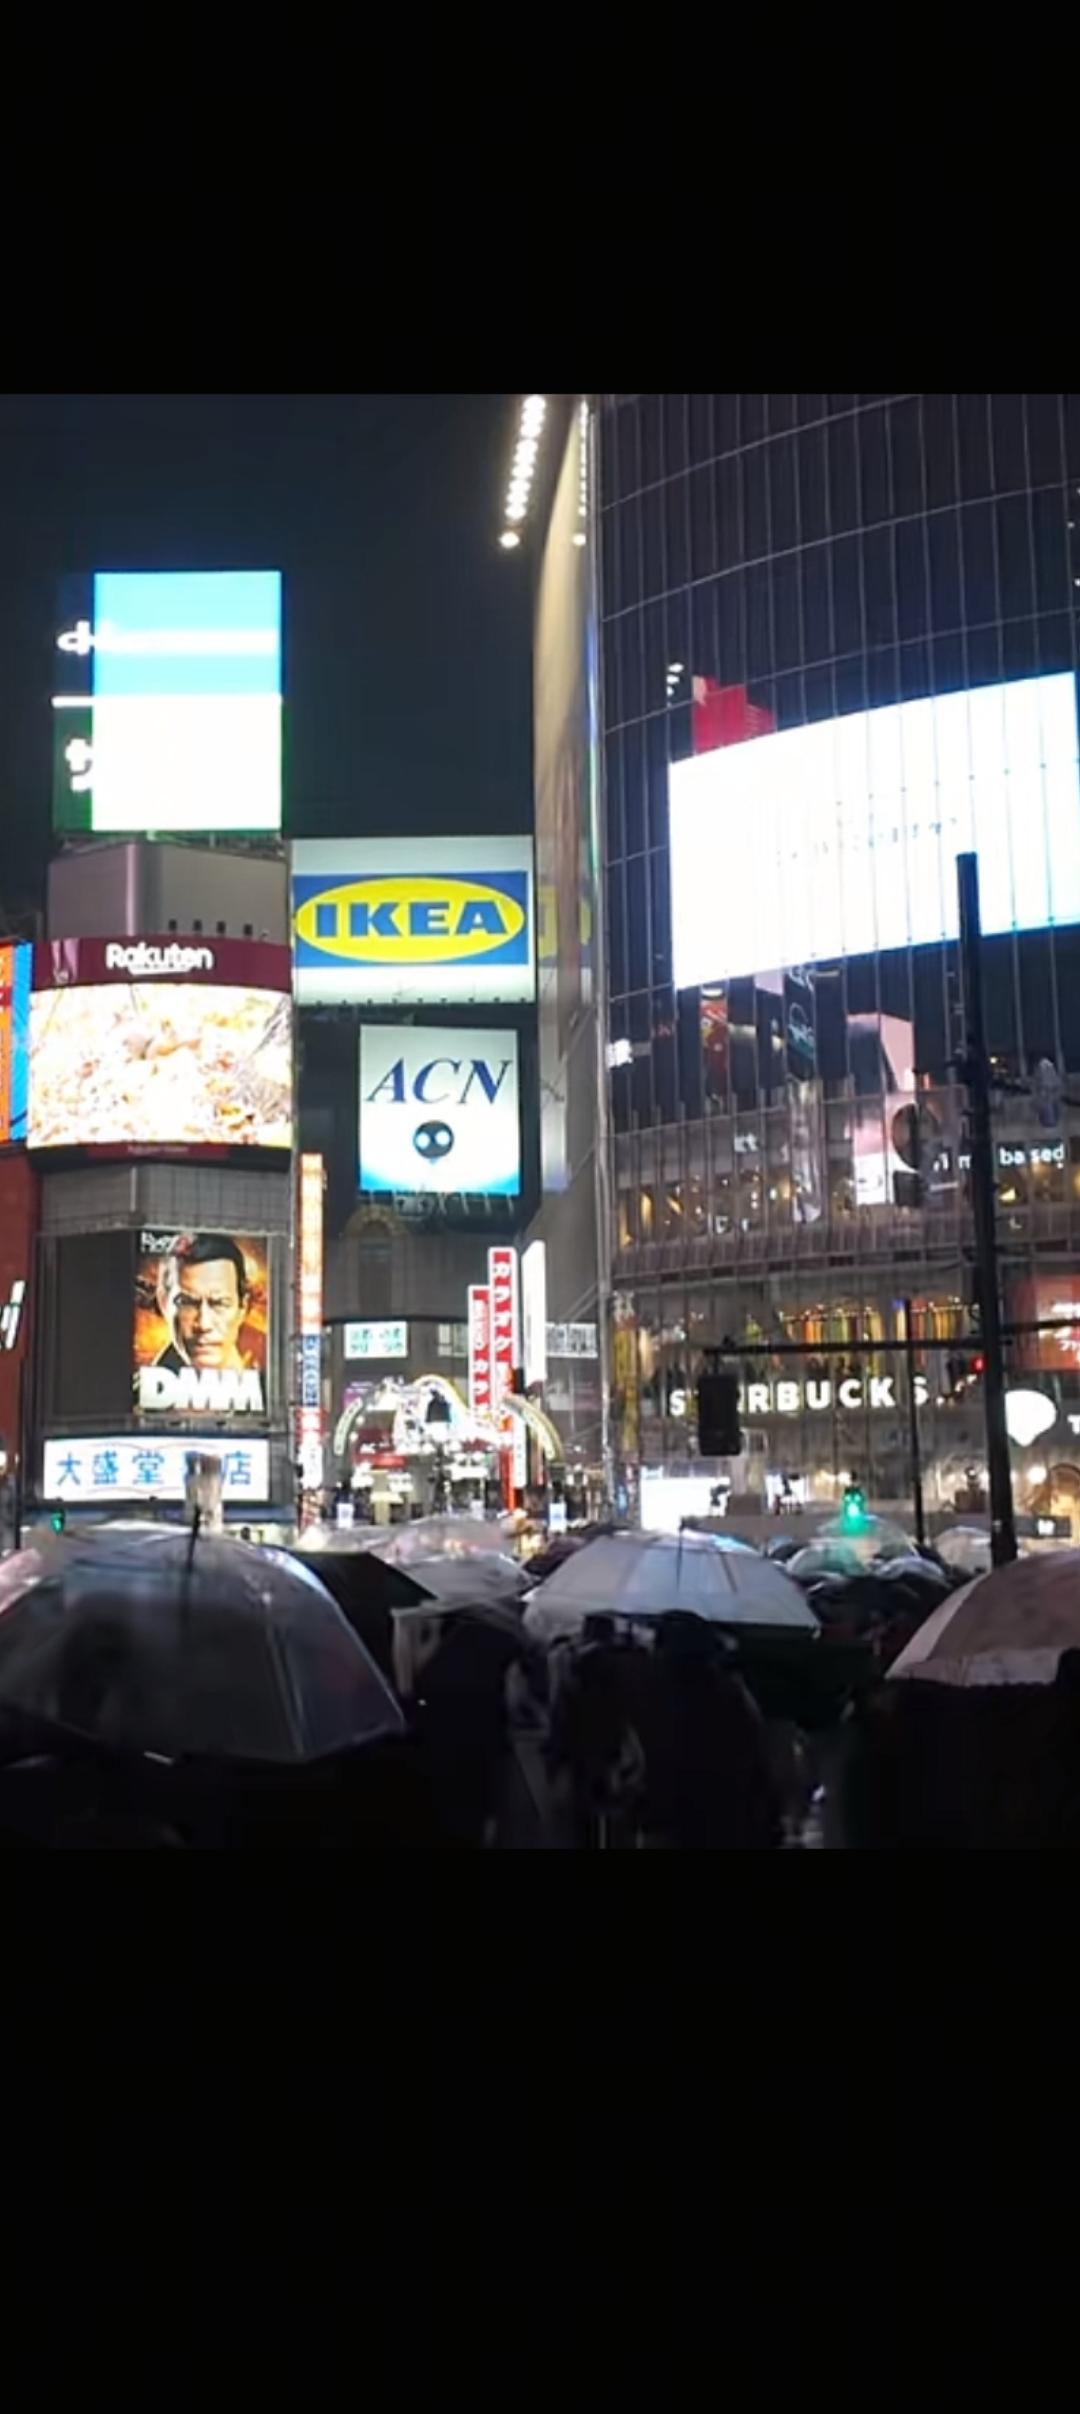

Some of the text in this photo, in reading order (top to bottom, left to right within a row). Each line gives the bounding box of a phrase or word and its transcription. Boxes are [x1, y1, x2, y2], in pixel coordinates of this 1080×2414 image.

[316, 901, 508, 938] IKEA
[106, 942, 213, 970] Rakuten
[366, 1058, 513, 1104] ACN
[139, 1366, 264, 1411] DMM
[668, 1377, 930, 1417] SRBUCKS
[56, 1449, 253, 1486] 大盛堂店
